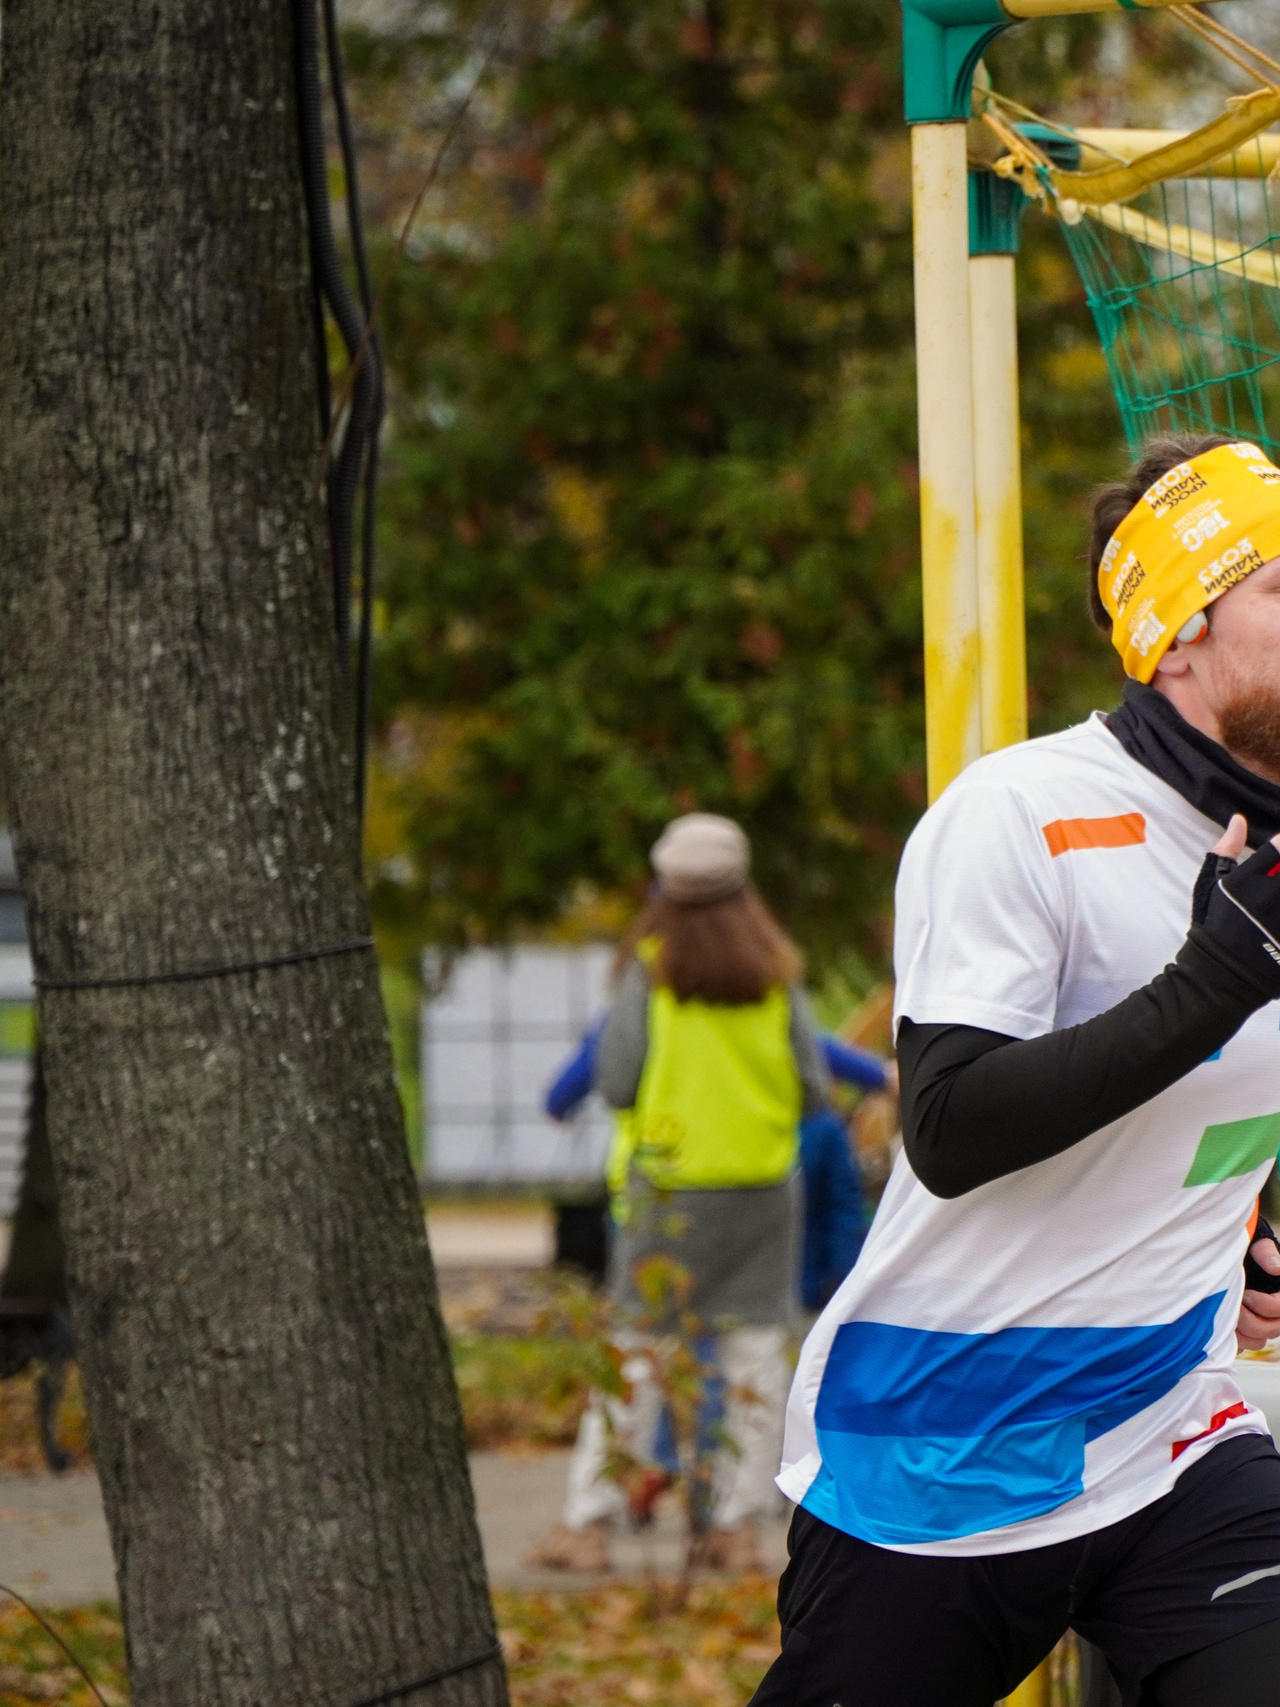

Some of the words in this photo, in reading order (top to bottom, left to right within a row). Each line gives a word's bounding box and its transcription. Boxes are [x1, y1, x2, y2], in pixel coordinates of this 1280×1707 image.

[1150, 472, 1201, 511] НАЦИИ
[1166, 479, 1208, 510] КРОСС
[1197, 537, 1254, 585] 2023
[1204, 550, 1261, 595] НАЦИИ
